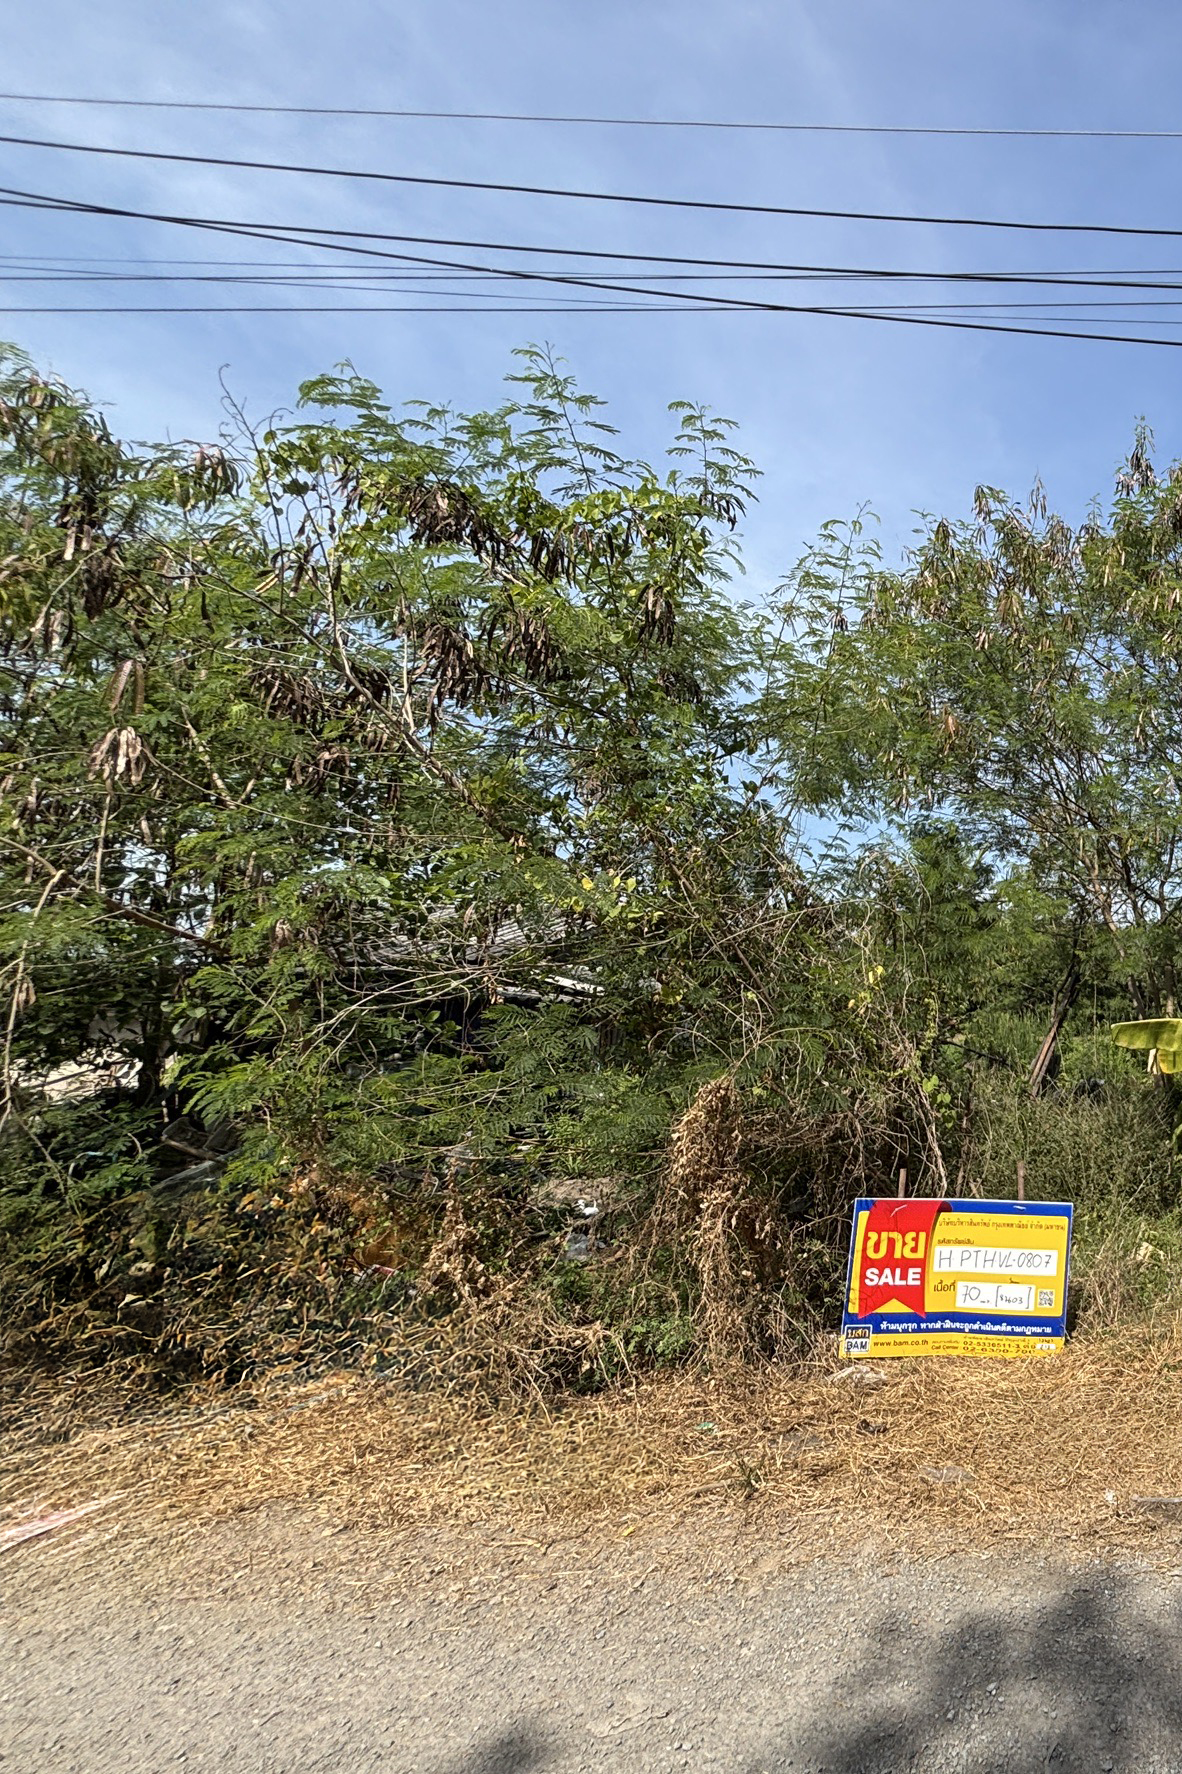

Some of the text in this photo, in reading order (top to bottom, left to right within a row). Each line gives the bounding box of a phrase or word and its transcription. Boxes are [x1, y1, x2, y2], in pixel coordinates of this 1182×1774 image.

[866, 1231, 927, 1259] ขาย
[864, 1267, 922, 1286] SALE
[880, 1321, 918, 1332] ห้ามบุกรุก
[846, 1340, 868, 1350] BAM
[873, 1339, 929, 1347] www.bam.co.th
